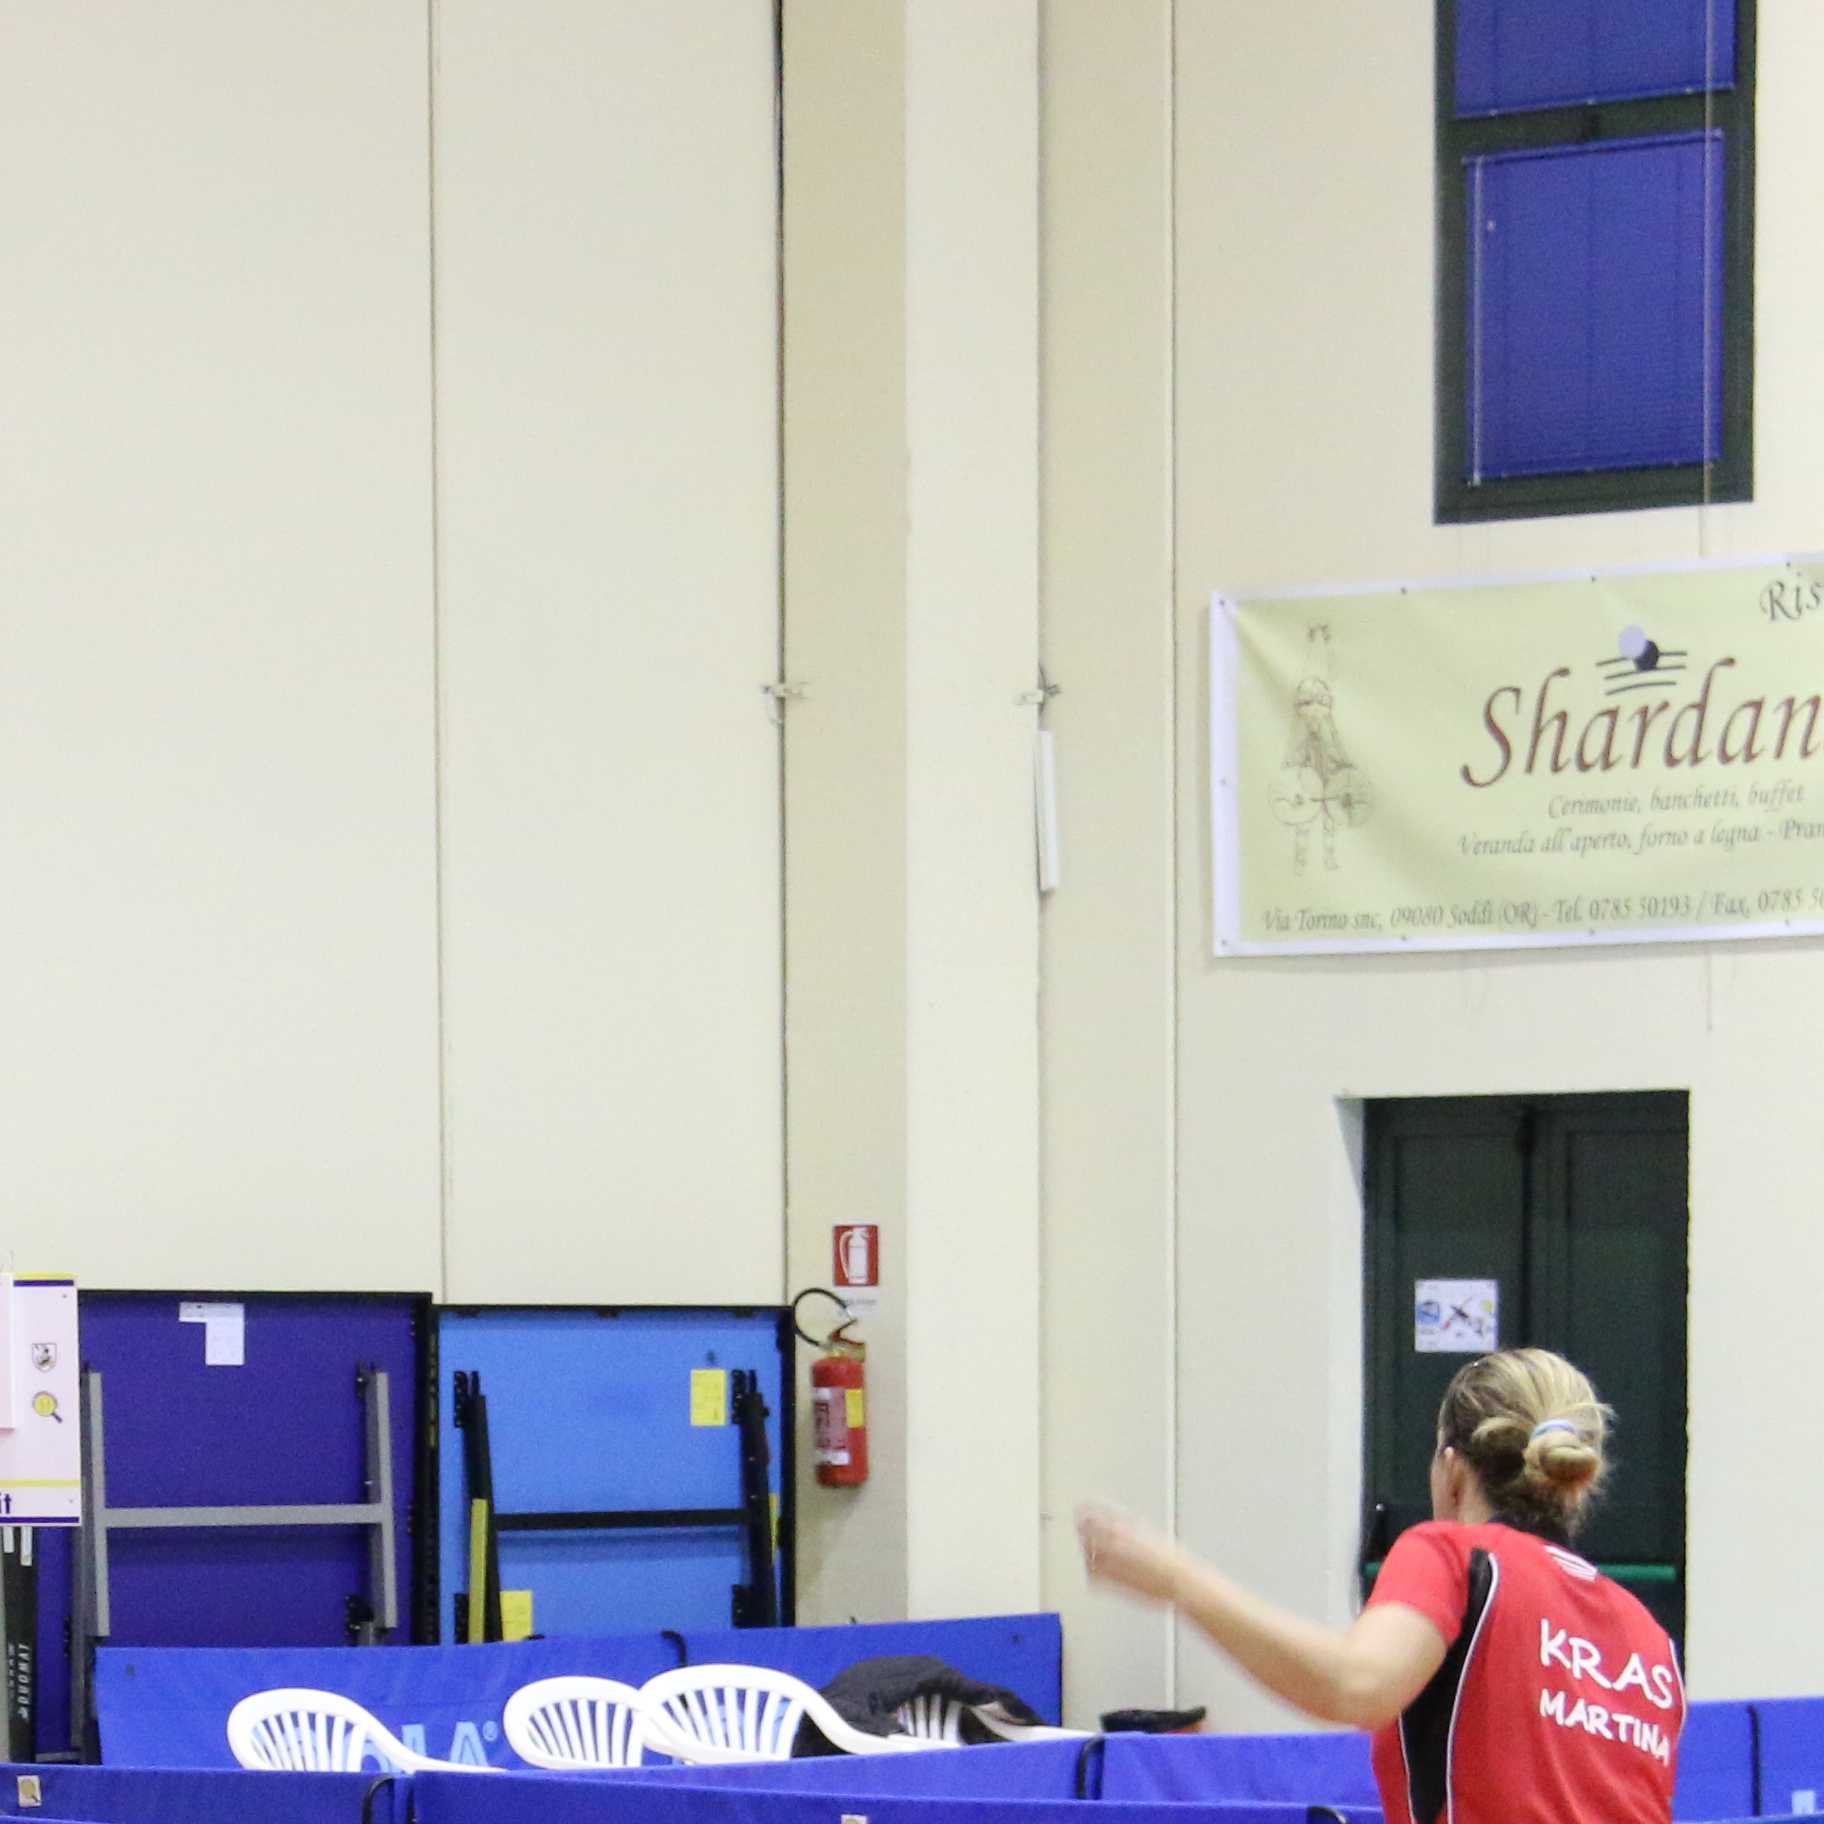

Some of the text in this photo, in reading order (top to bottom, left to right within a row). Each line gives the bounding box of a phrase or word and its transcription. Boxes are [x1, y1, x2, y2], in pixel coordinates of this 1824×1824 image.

[1749, 779, 1804, 812] buffet
[1458, 832, 1534, 856] Veranda
[1540, 1618, 1673, 1709] KRAS
[1539, 1688, 1670, 1766] MARTINA
